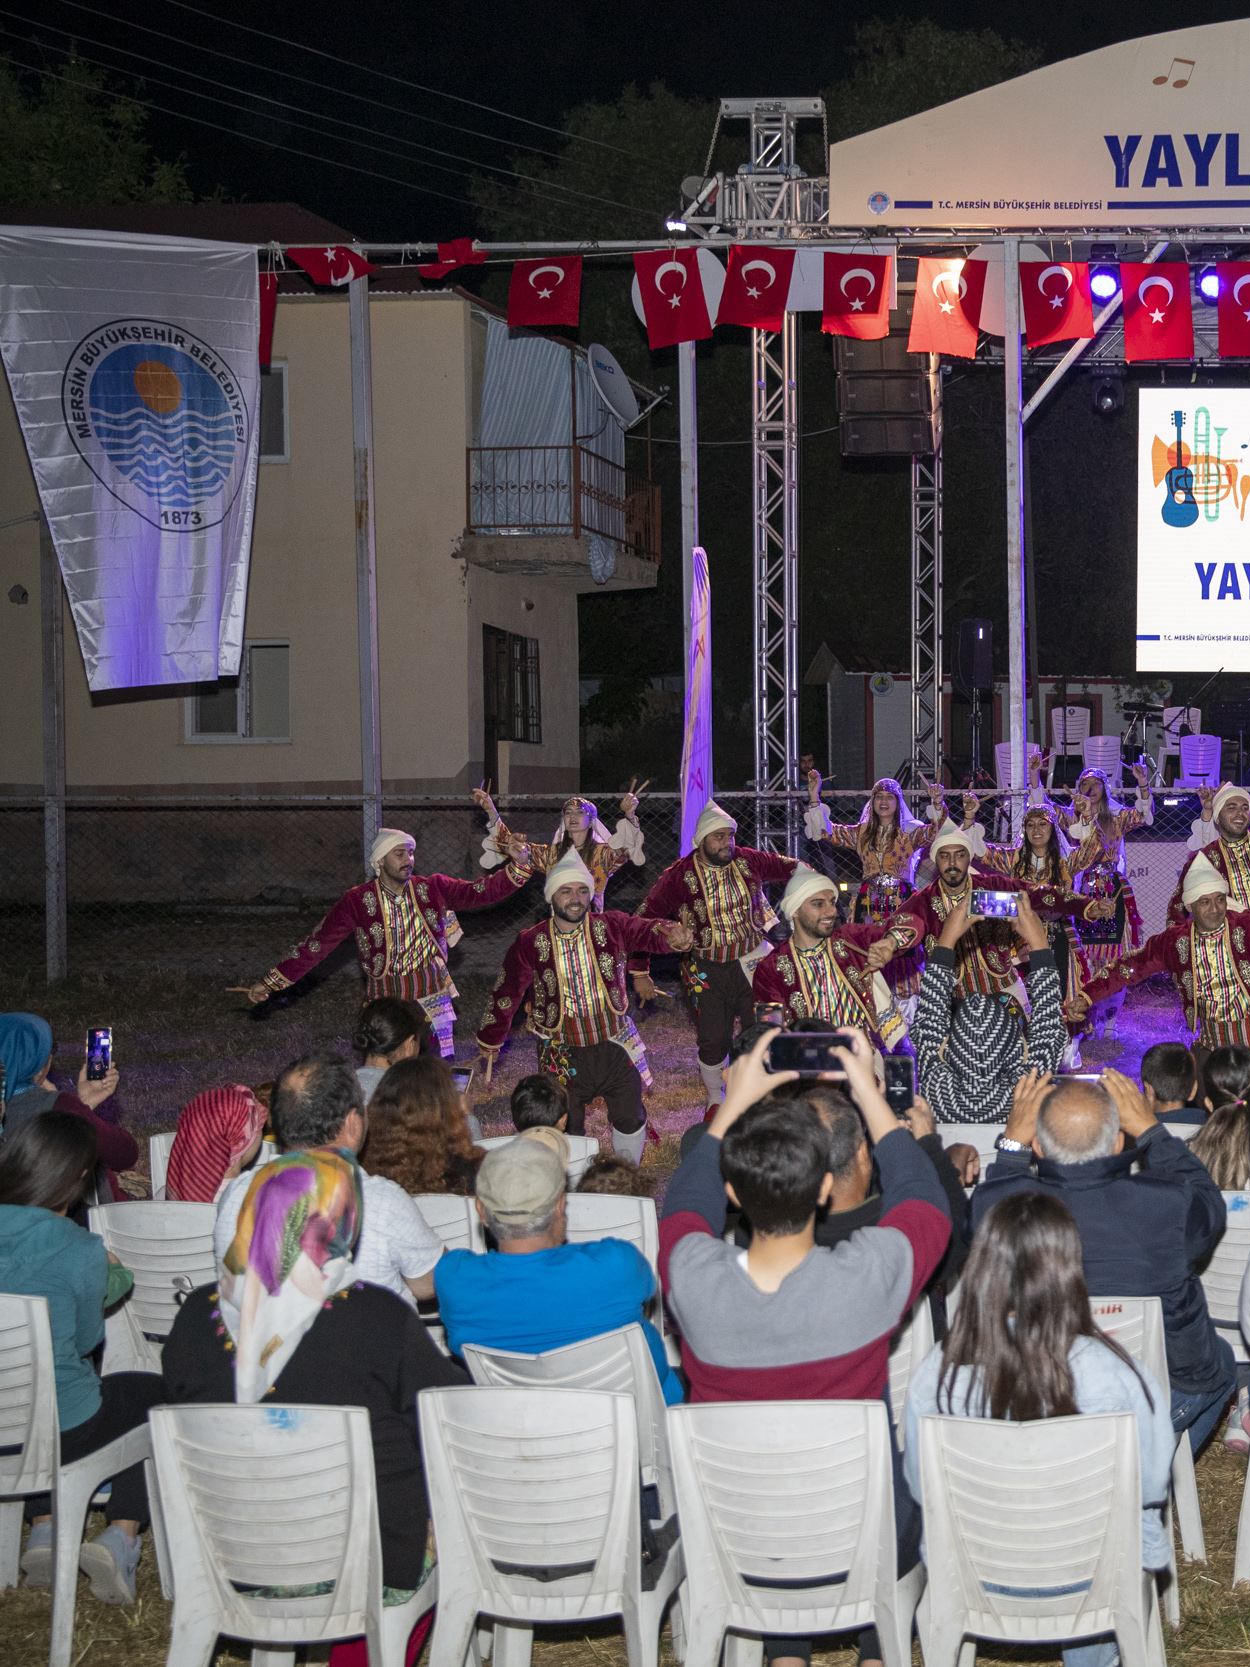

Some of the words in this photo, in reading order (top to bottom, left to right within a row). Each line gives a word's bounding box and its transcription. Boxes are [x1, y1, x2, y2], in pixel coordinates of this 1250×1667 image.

[938, 201, 953, 209] T.C.
[955, 199, 990, 209] MERSİN
[993, 199, 1051, 211] BÜYÜKŞEHİR
[1054, 199, 1102, 210] BELEDİYESİ
[67, 367, 92, 439] MERSİN
[80, 326, 185, 367] BÜYÜKŞEHİR
[189, 343, 246, 444] BELEDİYESİ
[160, 511, 203, 525] 1873
